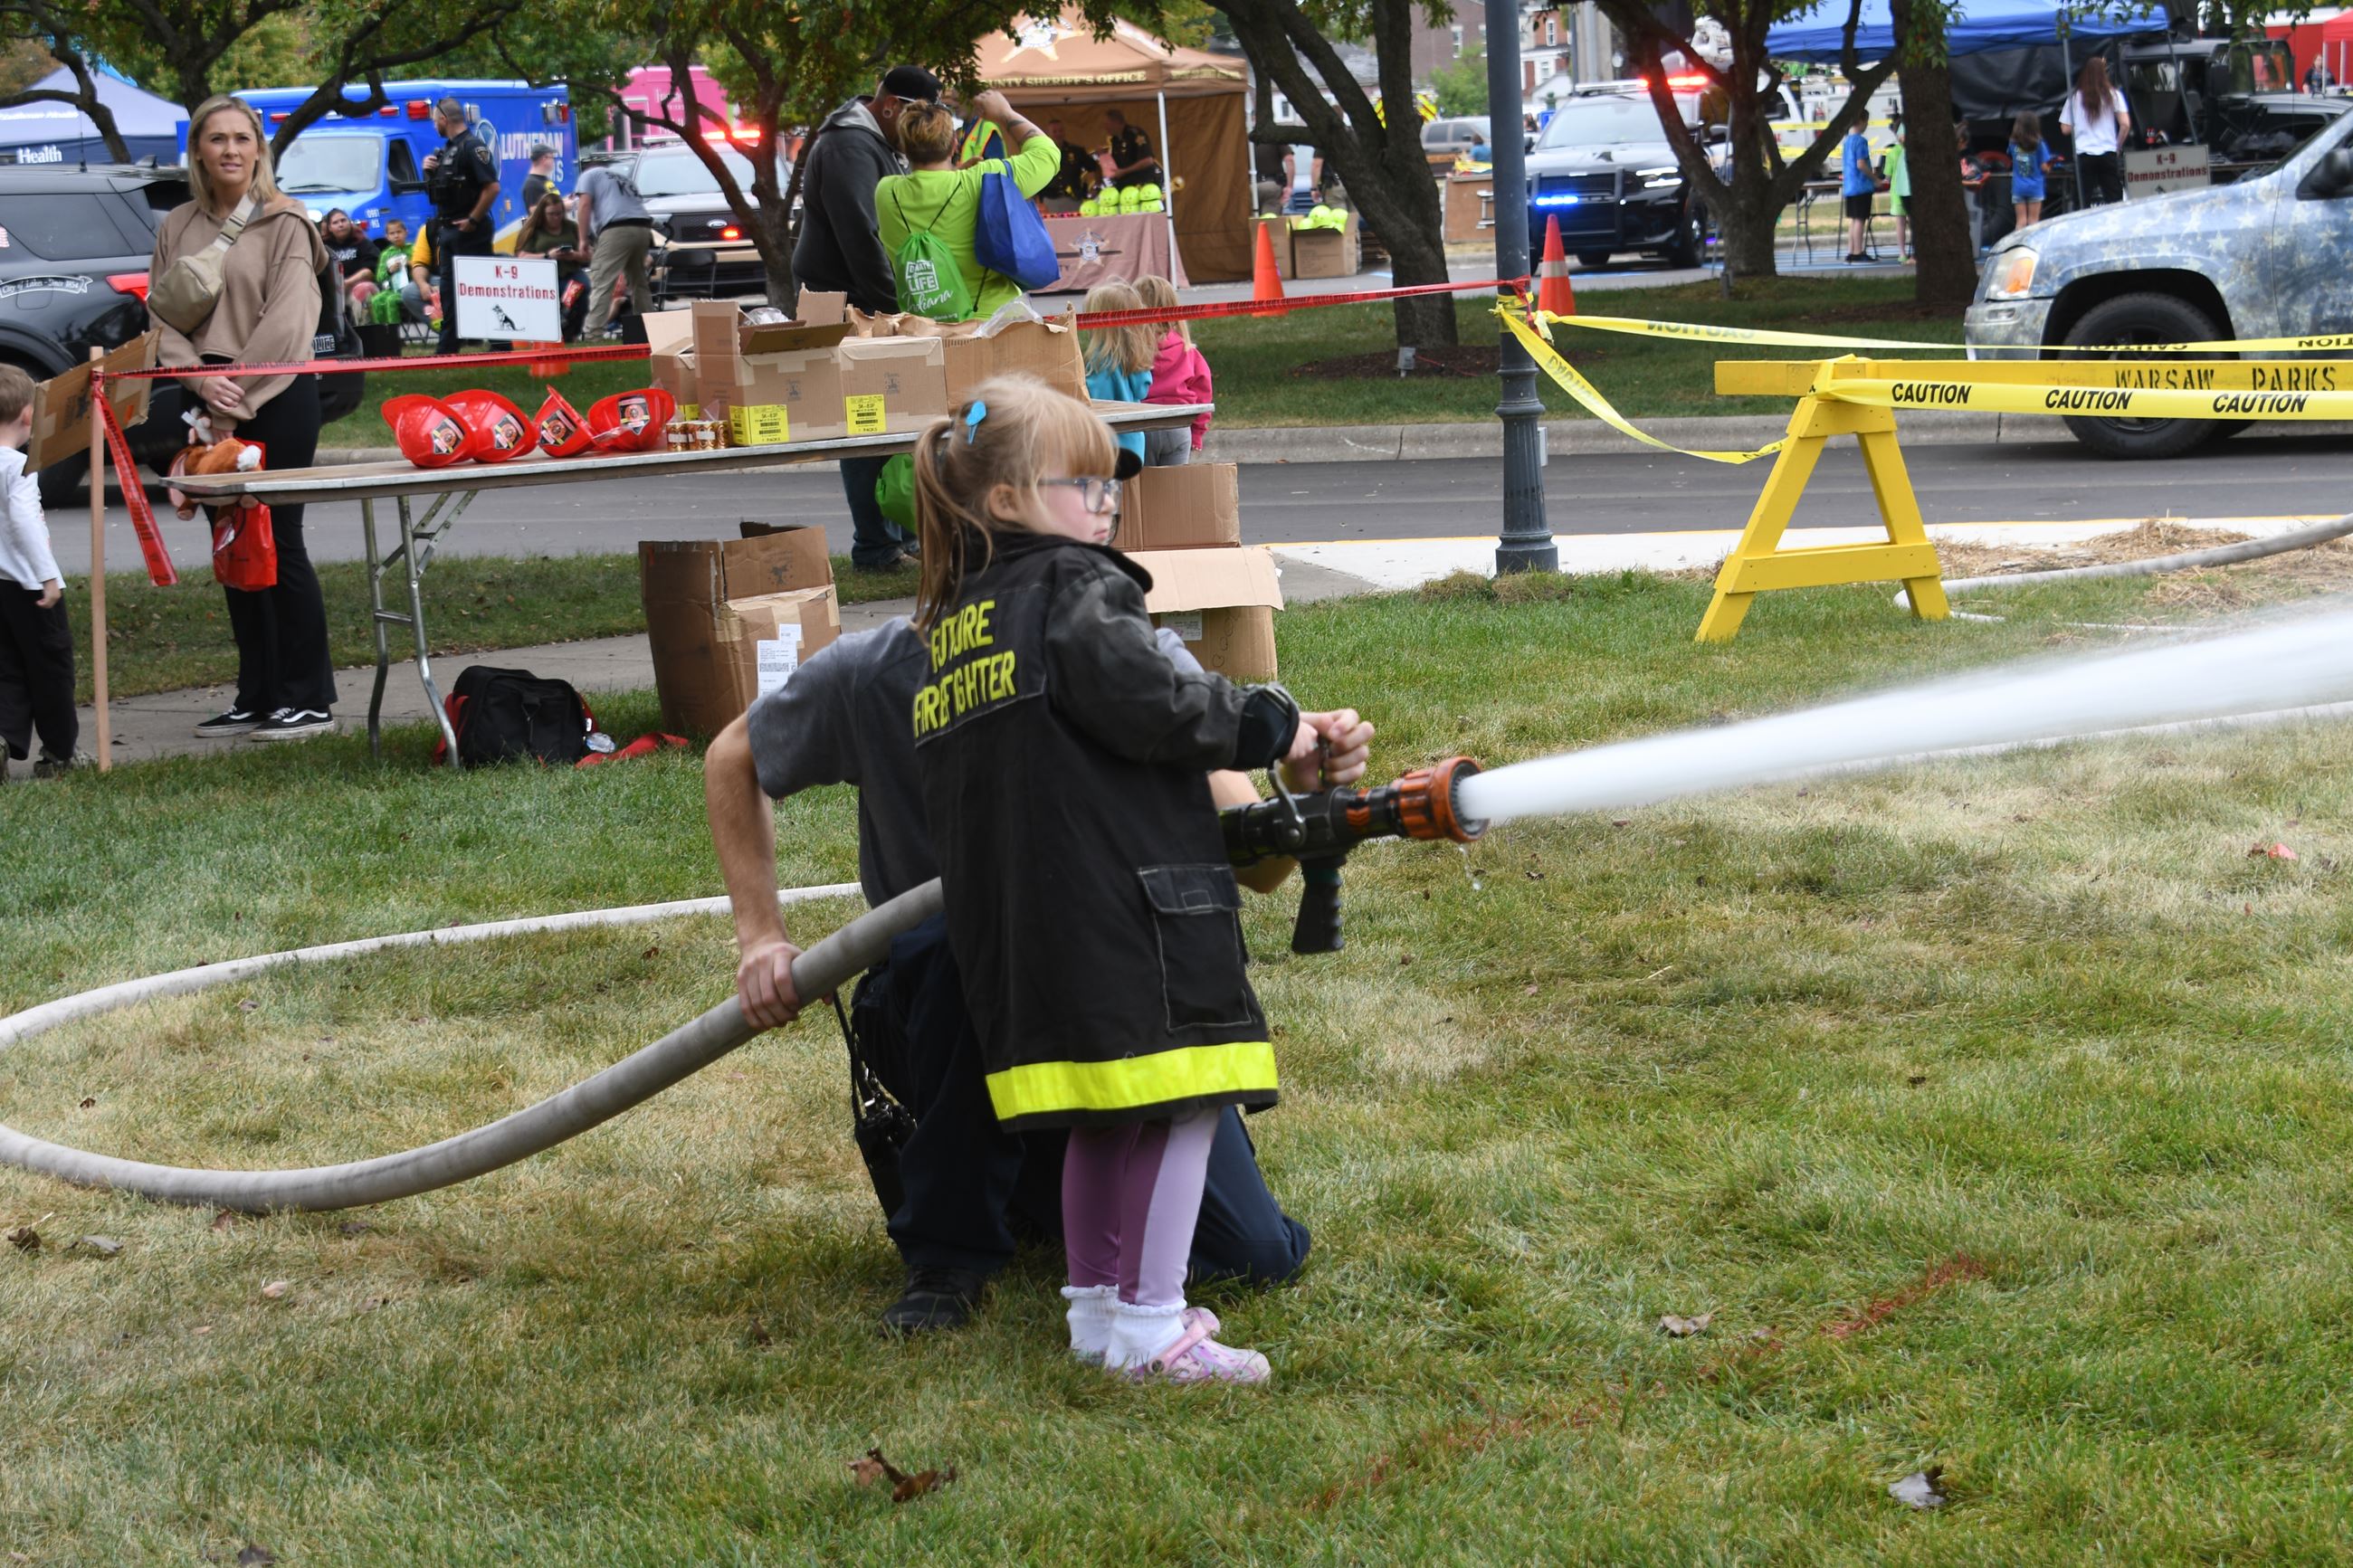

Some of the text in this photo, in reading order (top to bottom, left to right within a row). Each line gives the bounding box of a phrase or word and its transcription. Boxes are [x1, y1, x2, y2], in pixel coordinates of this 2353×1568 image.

[980, 70, 1147, 88] UNTY SHERIFF'S OFFICE
[16, 145, 62, 164] Health
[2157, 153, 2176, 165] K-9
[2128, 166, 2207, 183] Demonstrations
[495, 265, 519, 279] K-9
[459, 282, 557, 300] Demonstrations
[909, 275, 936, 291] LIFE
[901, 290, 953, 313] Indiana
[2297, 338, 2353, 348] TION
[2115, 366, 2337, 392] WARSAW PARKS
[1891, 383, 2310, 413] CAUTION CAUTION CAUTION
[930, 600, 995, 673] FUTURE
[913, 650, 1015, 738] FIREFIGHTER
